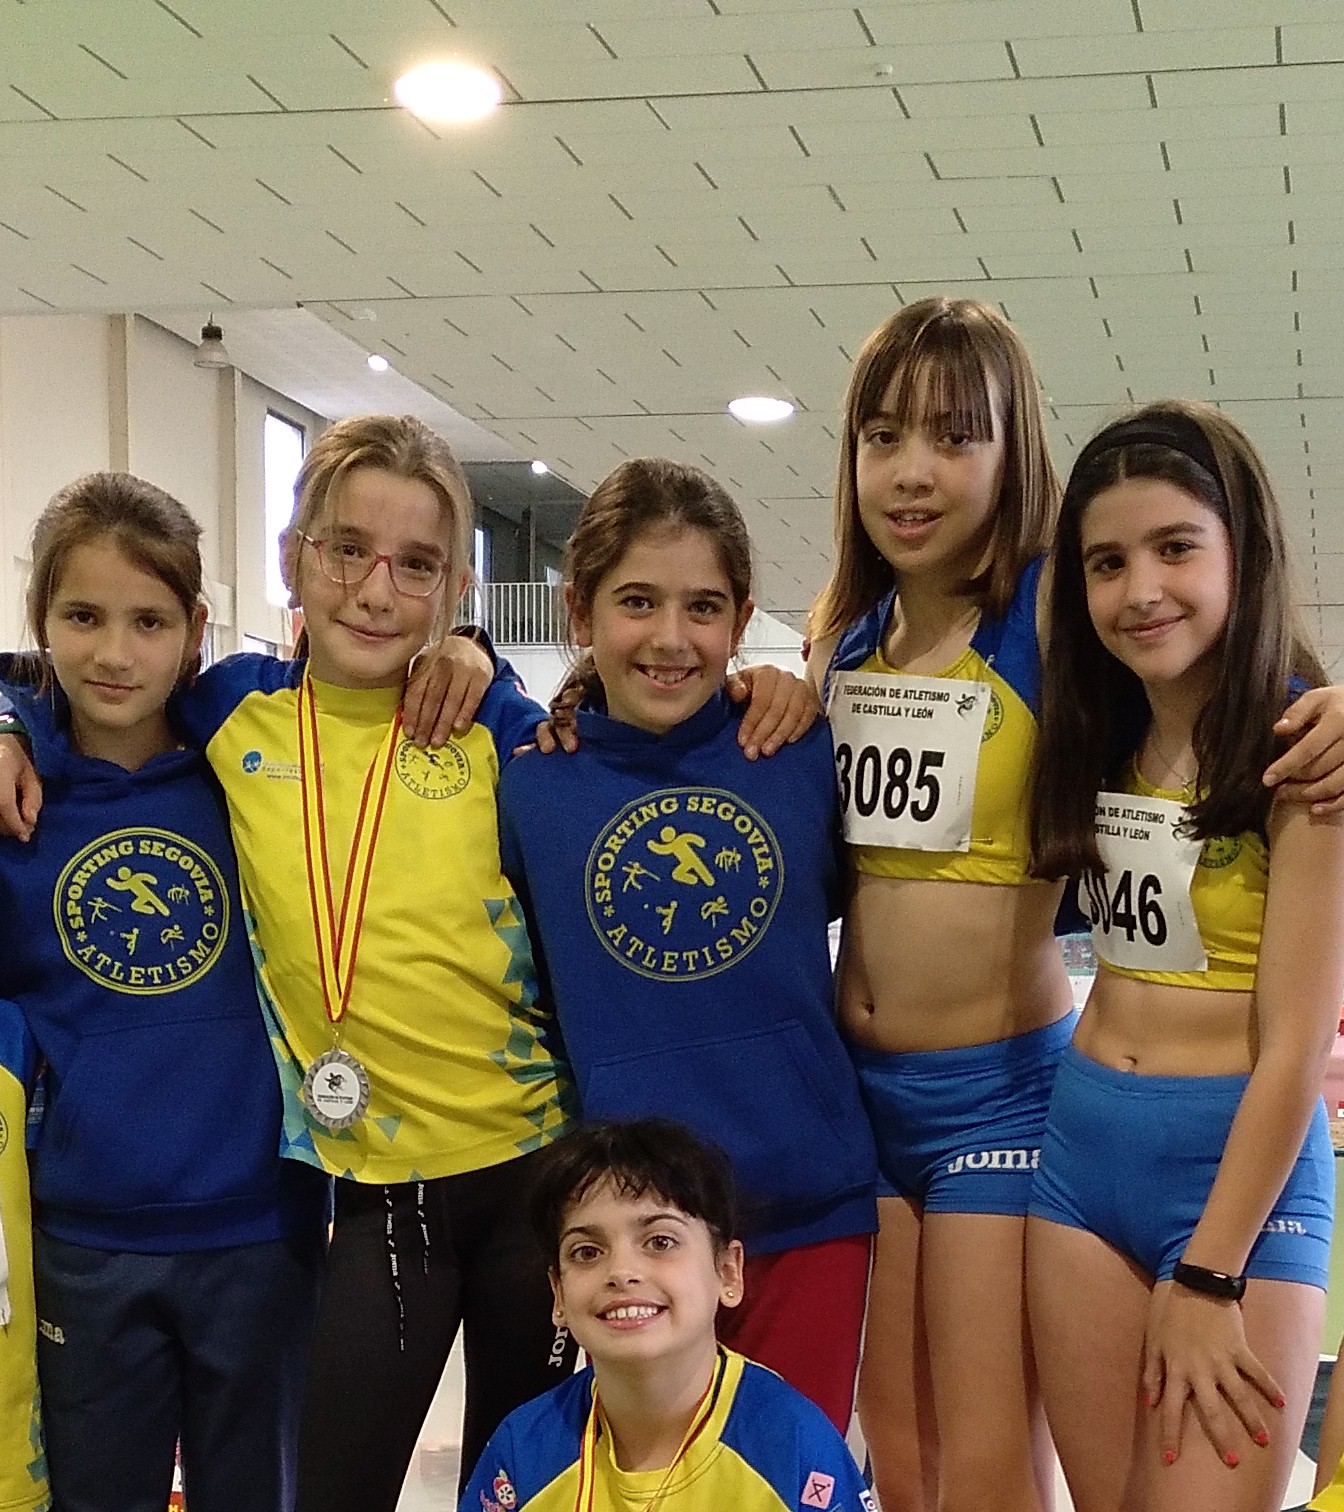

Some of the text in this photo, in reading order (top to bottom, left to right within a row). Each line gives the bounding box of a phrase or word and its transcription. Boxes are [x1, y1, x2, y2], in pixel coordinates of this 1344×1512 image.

[843, 684, 950, 703] FEDERACIÓN DE ATLETISMO
[851, 703, 934, 719] DE CASTILLA Y LEÓN
[401, 772, 468, 799] ATLETISMO
[836, 743, 945, 822] 3085
[1095, 823, 1151, 841] STILLA Y LEÓN
[1108, 806, 1120, 818] DE
[1121, 809, 1166, 824] ATLETISMO
[595, 796, 774, 904] SPORTING SEGOVIA
[68, 839, 216, 931] SPORTING SEGOVIA
[75, 921, 220, 986] ATLETISMO
[606, 896, 769, 973] ATLETISMO
